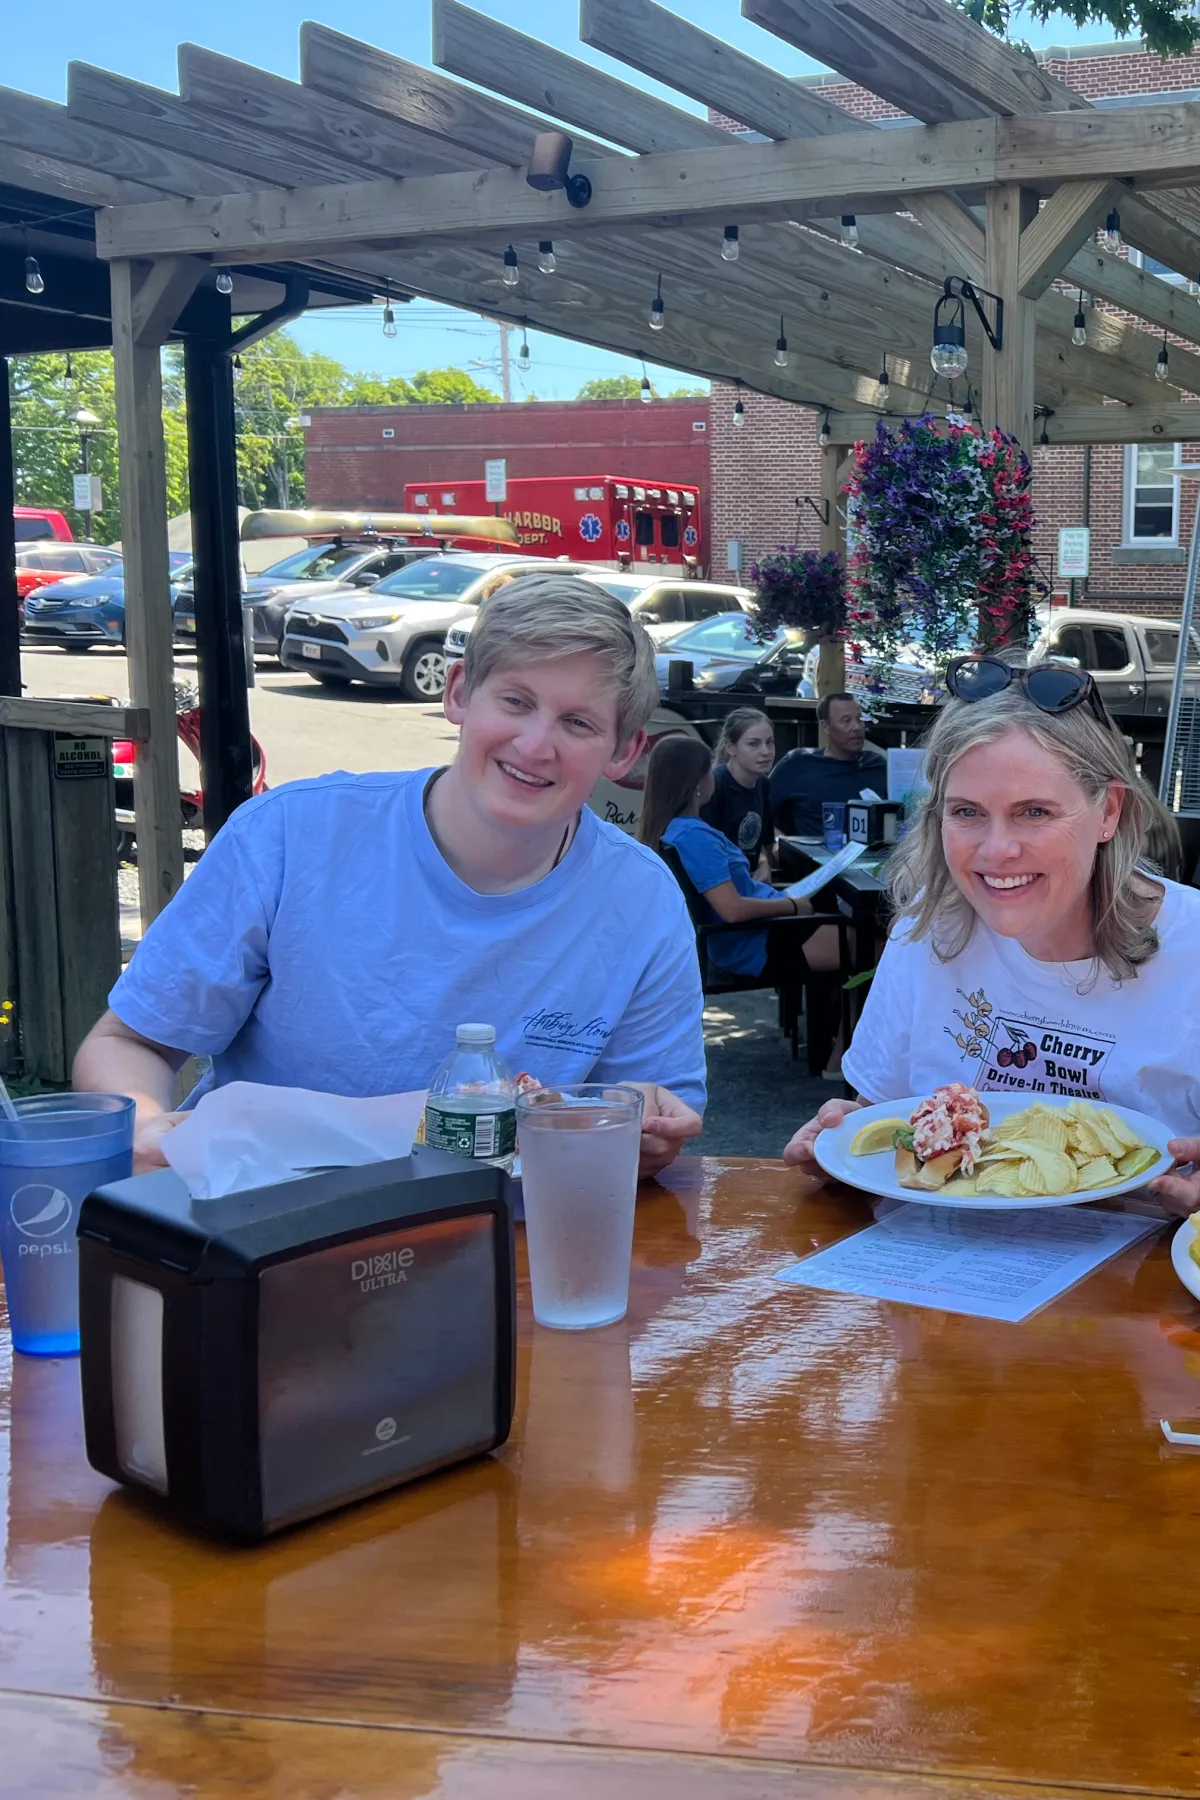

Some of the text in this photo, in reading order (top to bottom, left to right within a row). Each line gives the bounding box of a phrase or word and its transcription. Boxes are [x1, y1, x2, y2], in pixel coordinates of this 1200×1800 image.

[60, 751, 102, 761] ALCOHOL
[74, 741, 86, 751] NO
[852, 816, 867, 834] D1
[1040, 1034, 1105, 1067] Cherry
[1044, 1059, 1088, 1087] Bowl
[986, 1068, 1045, 1092] Drive-In
[1050, 1081, 1101, 1100] Theatre
[18, 1240, 68, 1259] pepsi
[360, 1269, 408, 1293] ULTRA
